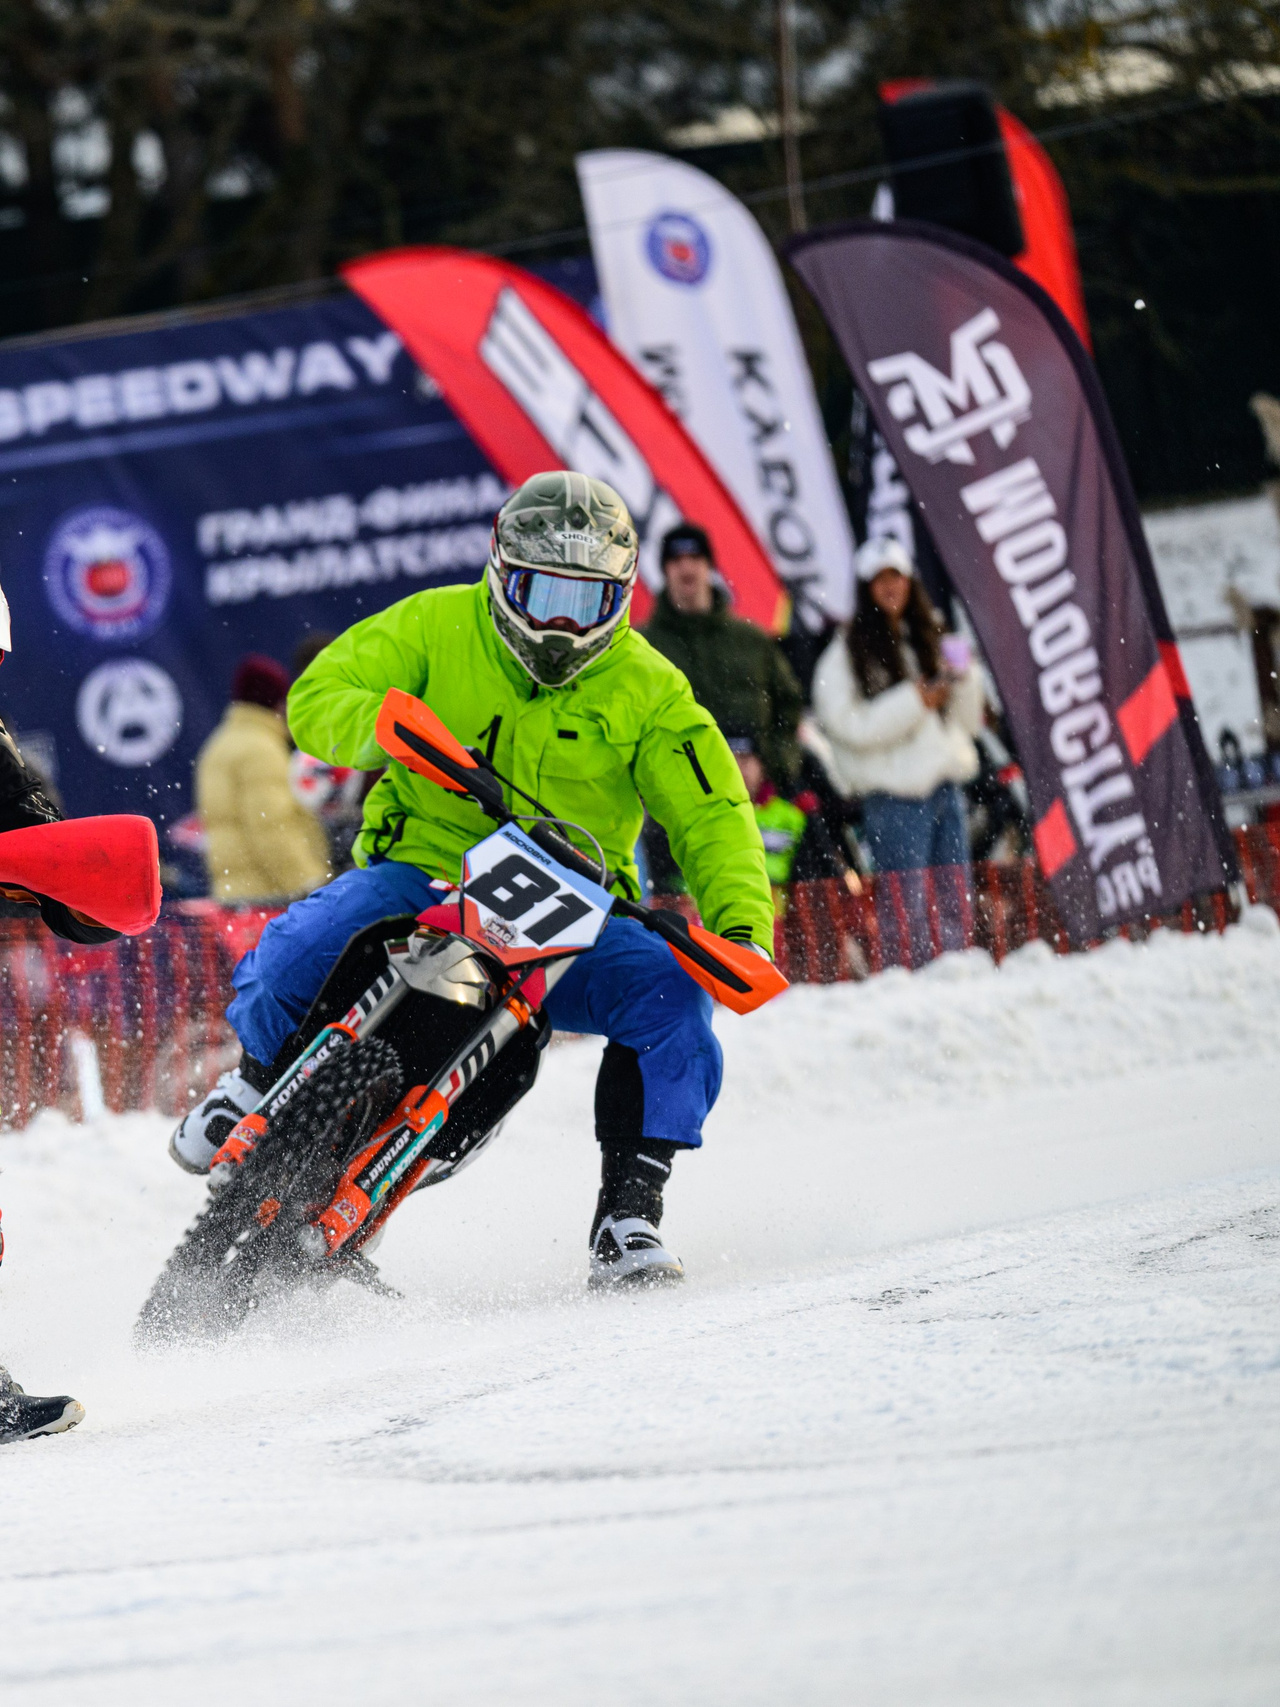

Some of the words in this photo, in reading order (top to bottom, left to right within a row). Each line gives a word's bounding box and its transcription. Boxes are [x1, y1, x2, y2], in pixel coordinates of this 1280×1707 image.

[196, 471, 506, 557] ГРАНД-ФИНА
[561, 533, 596, 545] SHOEI
[205, 522, 491, 607] КРЫЛАТСКО
[464, 853, 594, 947] 81
[269, 1045, 331, 1117] DNLOP
[368, 1129, 412, 1183] DUNLOP
